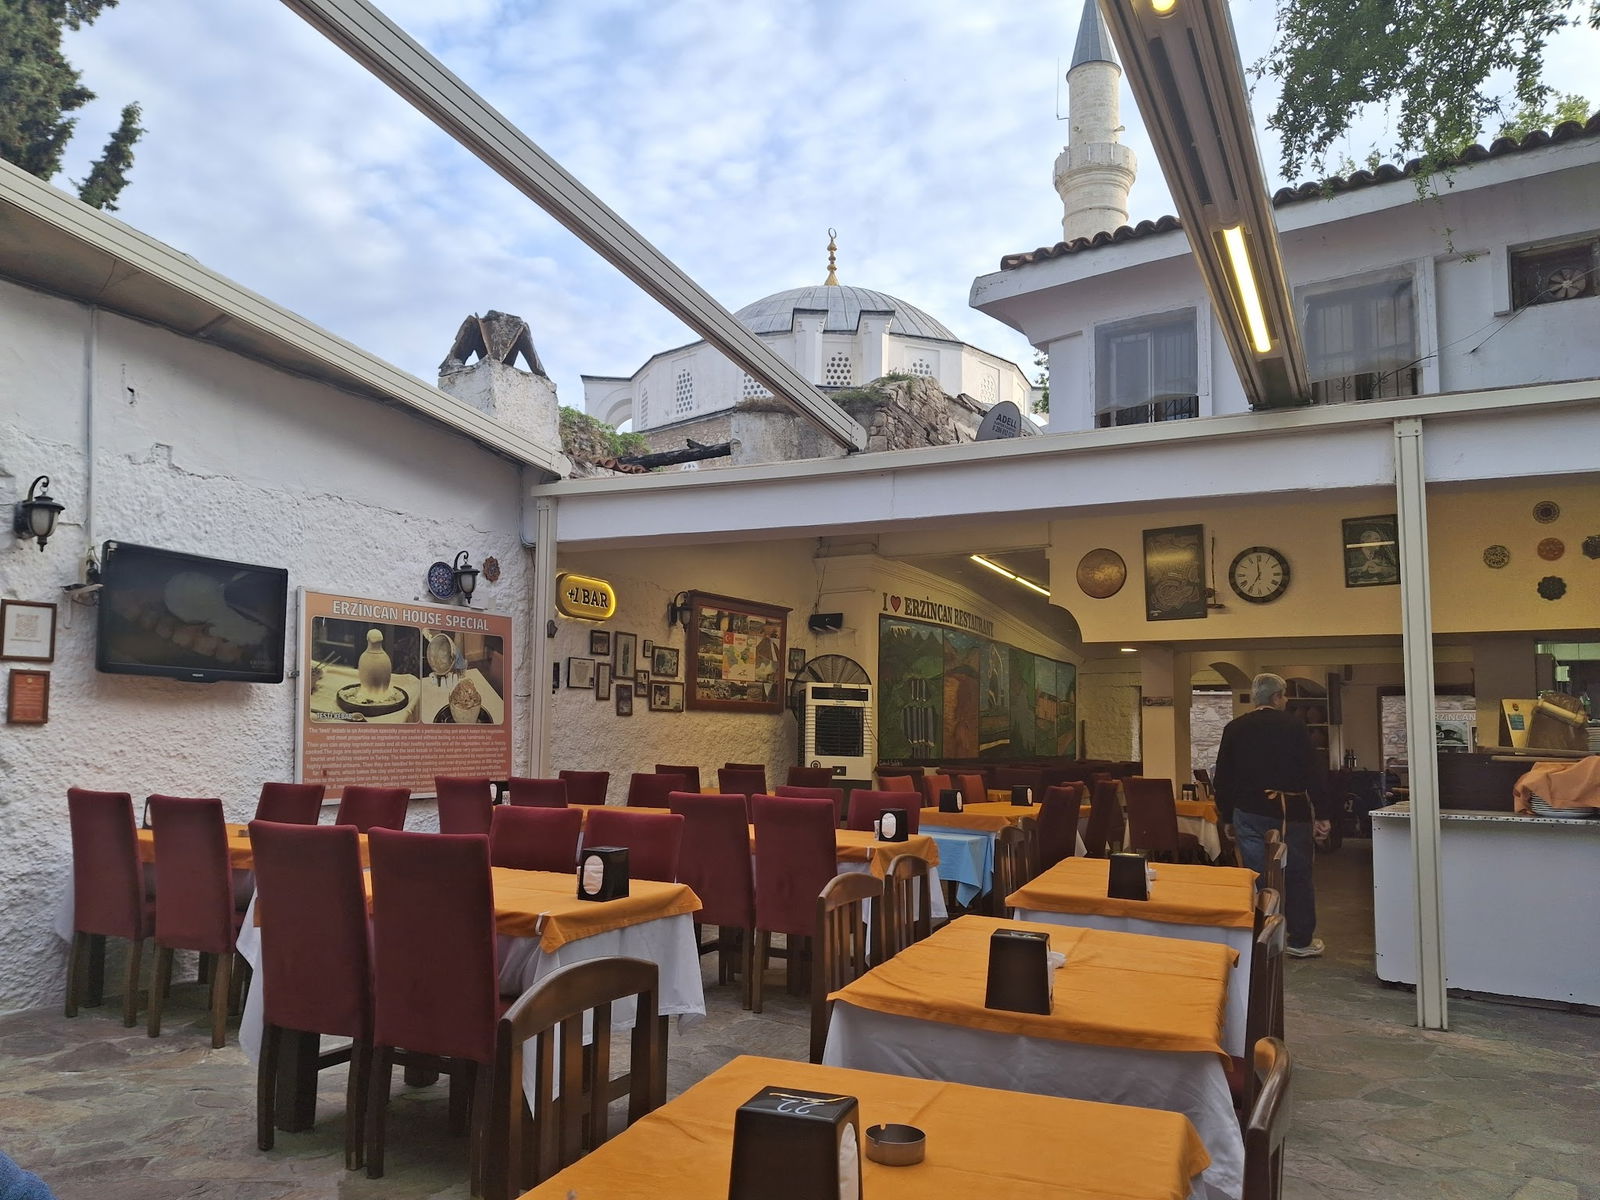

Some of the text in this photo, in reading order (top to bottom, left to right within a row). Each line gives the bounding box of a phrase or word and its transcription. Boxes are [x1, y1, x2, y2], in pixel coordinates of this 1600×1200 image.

[996, 413, 1016, 429] ADELL
[581, 588, 608, 608] BAR
[333, 600, 489, 631] ERZİNCAN HOUSE SPECIAL
[882, 592, 994, 637] I ERZİNCAN RESTAURANT
[1435, 712, 1476, 721] RZİNCAN
